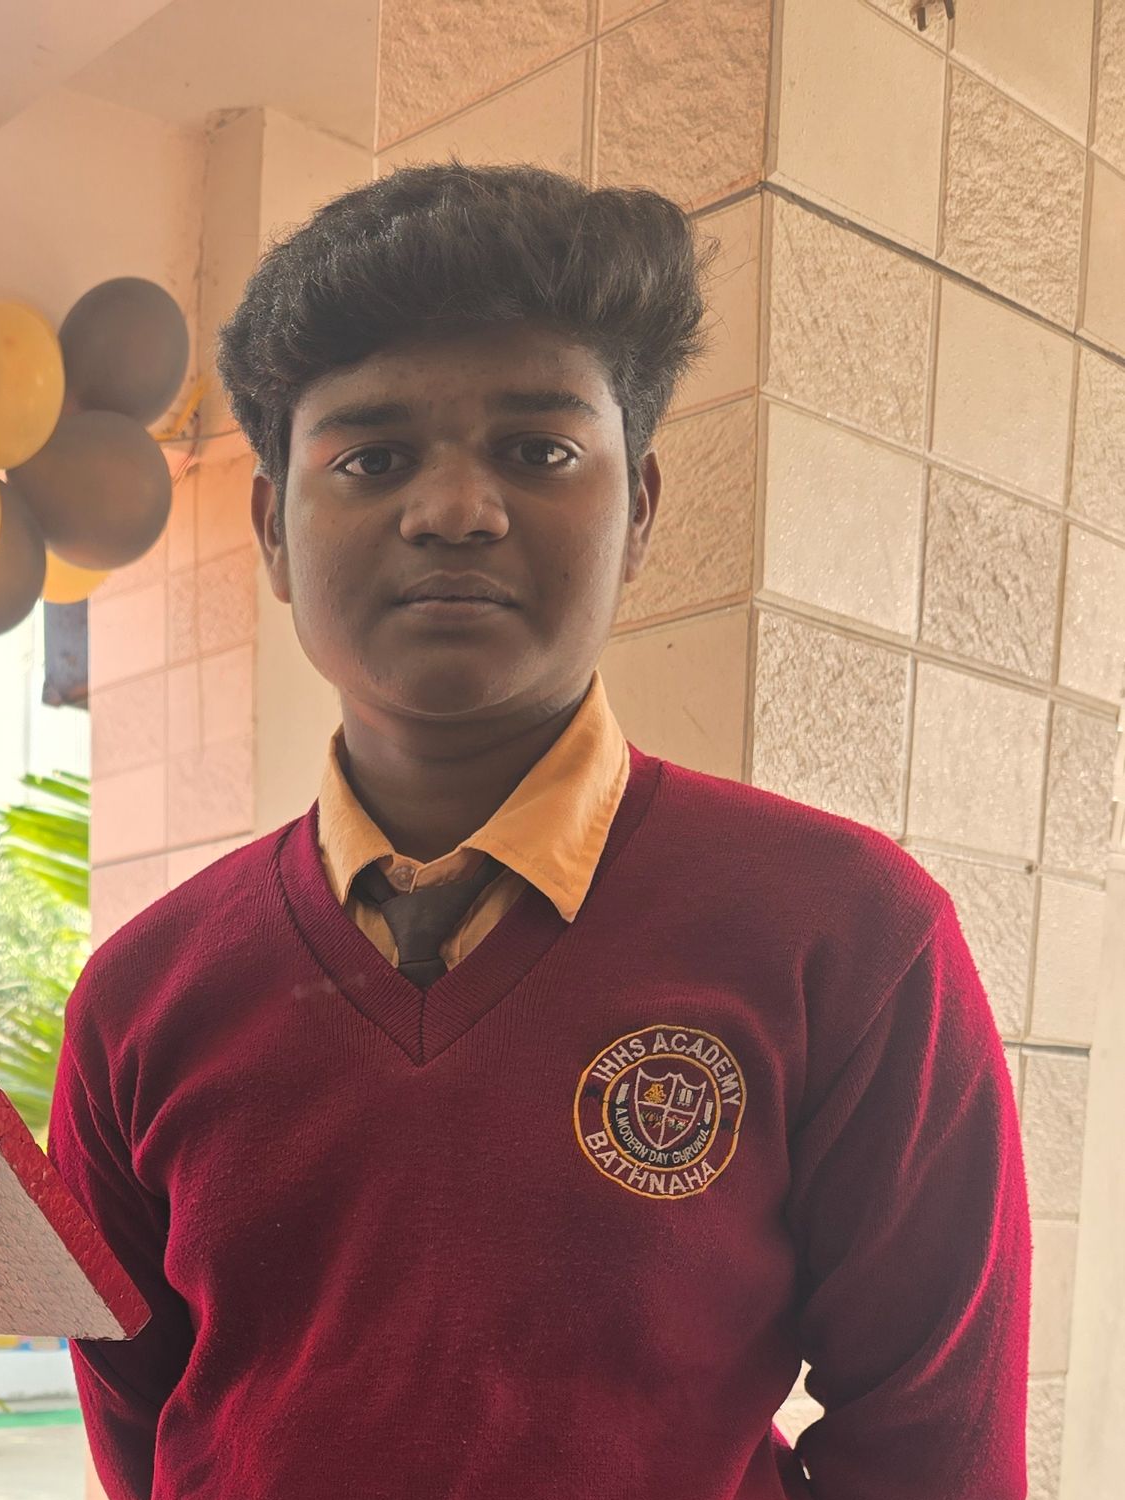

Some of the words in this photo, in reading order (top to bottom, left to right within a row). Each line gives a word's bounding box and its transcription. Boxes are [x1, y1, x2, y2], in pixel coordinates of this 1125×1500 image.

[591, 1038, 646, 1082] IHHS
[652, 1032, 741, 1106] ACADEMY
[649, 1151, 669, 1165] DAY
[672, 1129, 710, 1164] GURUKUL
